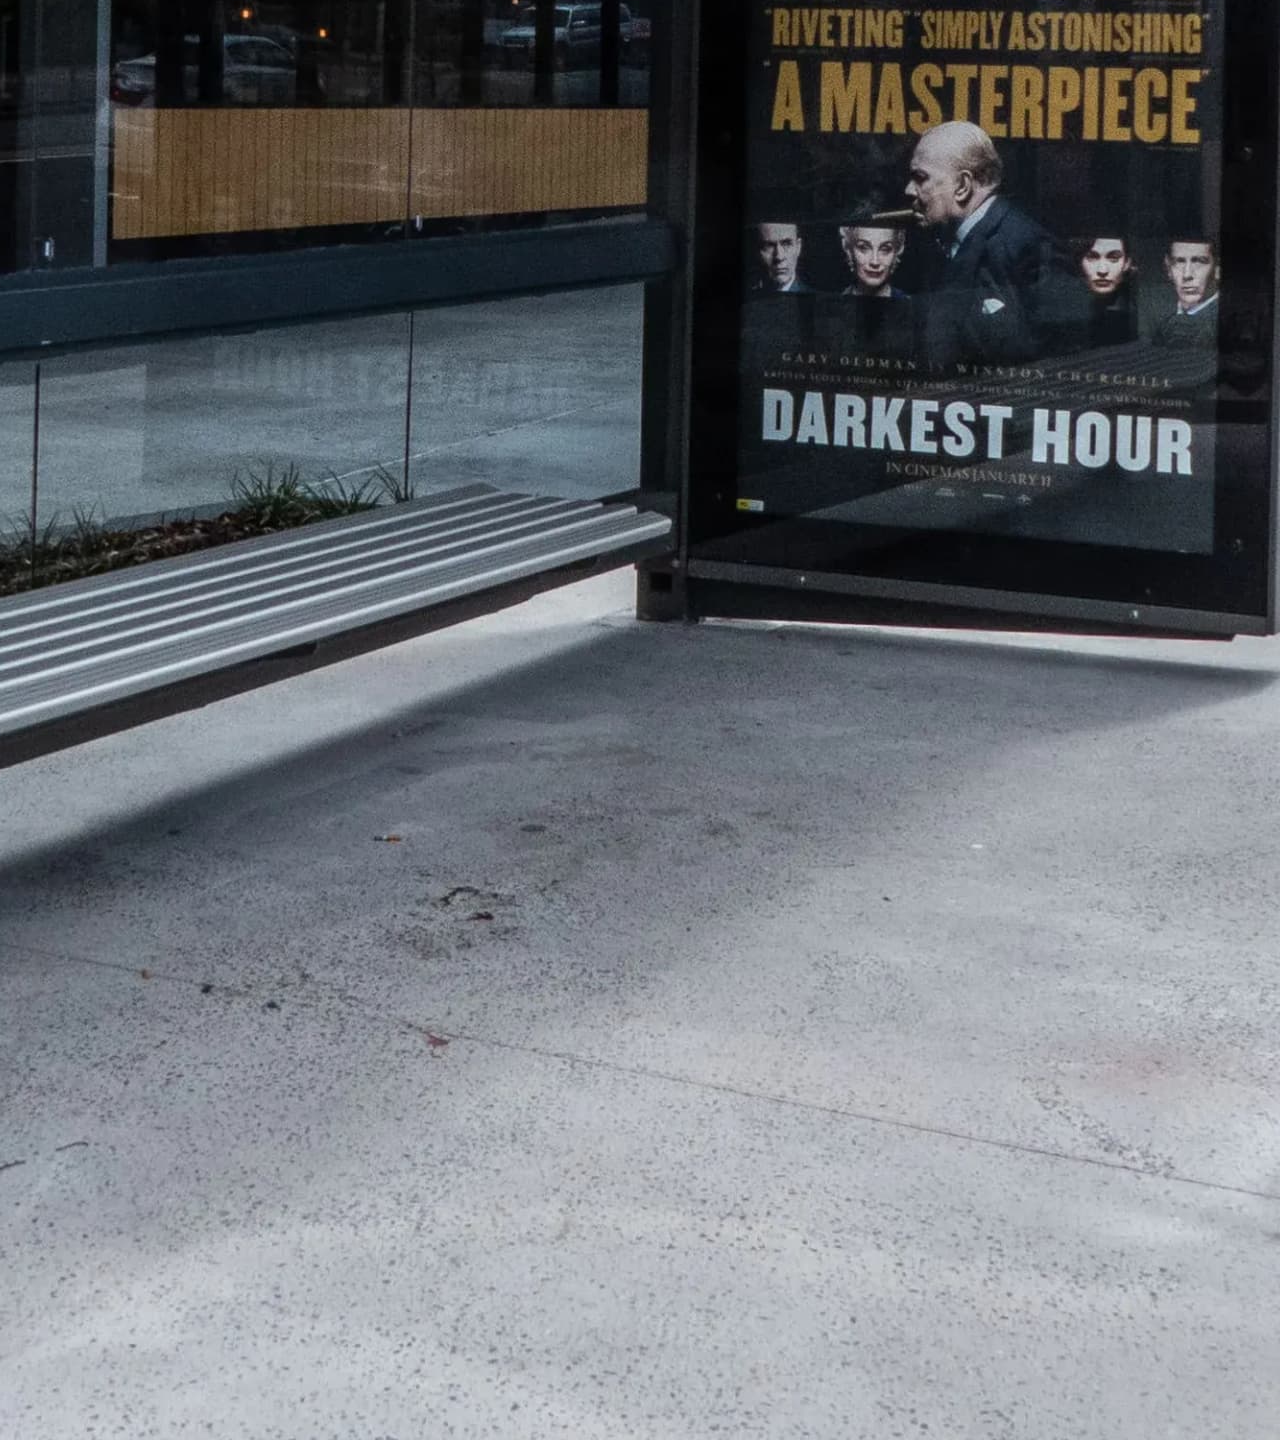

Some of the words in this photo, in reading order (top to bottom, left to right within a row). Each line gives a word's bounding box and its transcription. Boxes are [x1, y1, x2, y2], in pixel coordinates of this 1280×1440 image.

[955, 362, 1045, 381] WINSTON
[762, 387, 1013, 460] DARKEST
[1031, 407, 1193, 476] HOUR
[885, 461, 902, 474] IN
[903, 463, 970, 481] CINEMAS
[971, 467, 1038, 487] JANUARY
